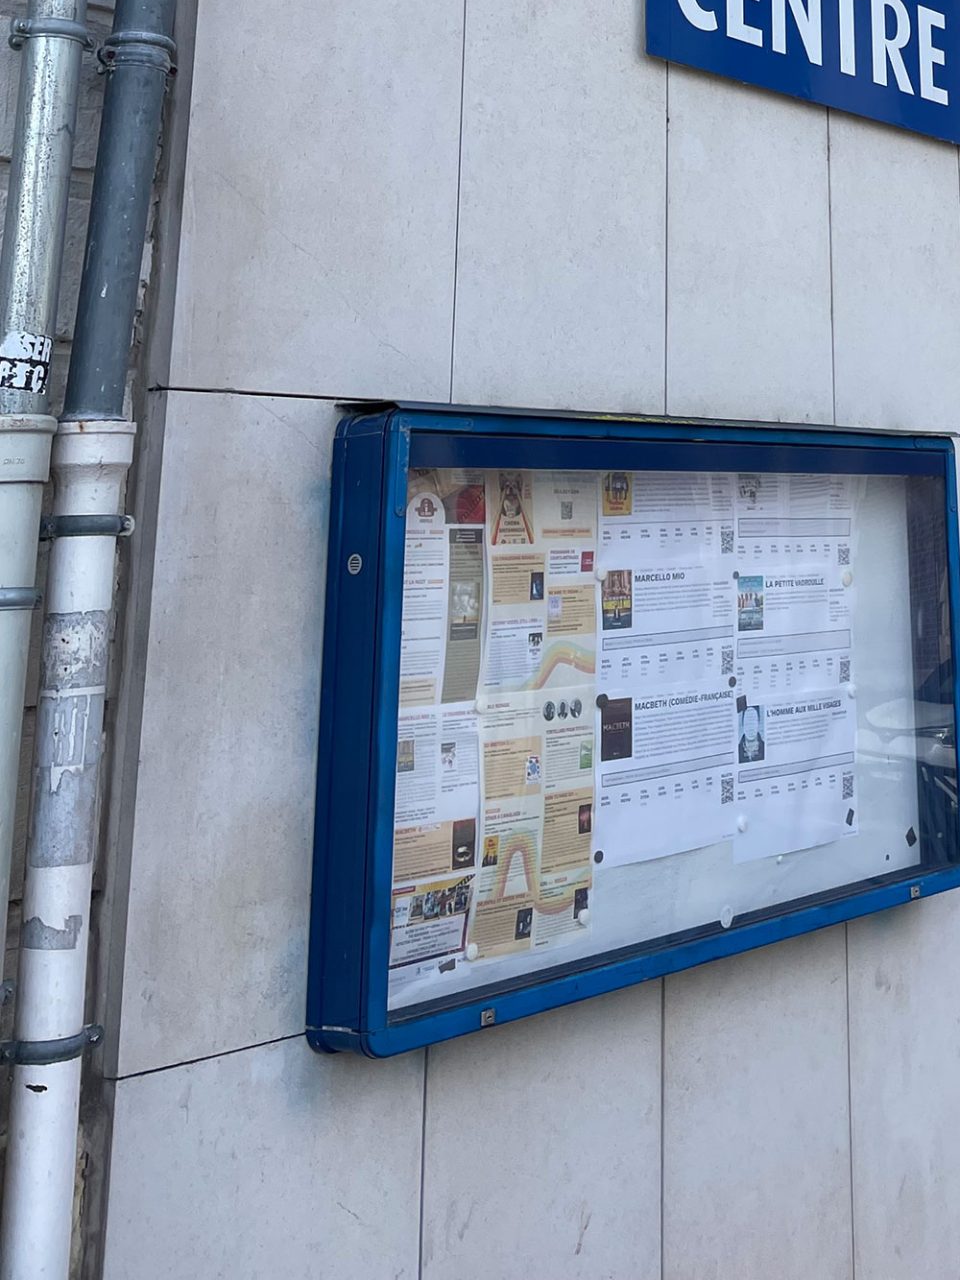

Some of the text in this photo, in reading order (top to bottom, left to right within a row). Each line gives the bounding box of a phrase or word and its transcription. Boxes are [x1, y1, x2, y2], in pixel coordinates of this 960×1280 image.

[634, 571, 685, 583] MARCELLO MIO
[765, 580, 774, 588] LA
[775, 579, 795, 588] PETITE
[634, 699, 667, 711] MACBETH
[766, 707, 794, 718] L'HOMME
[794, 705, 806, 714] AUX
[807, 703, 822, 712] MILLE
[602, 721, 630, 732] MACBETH
